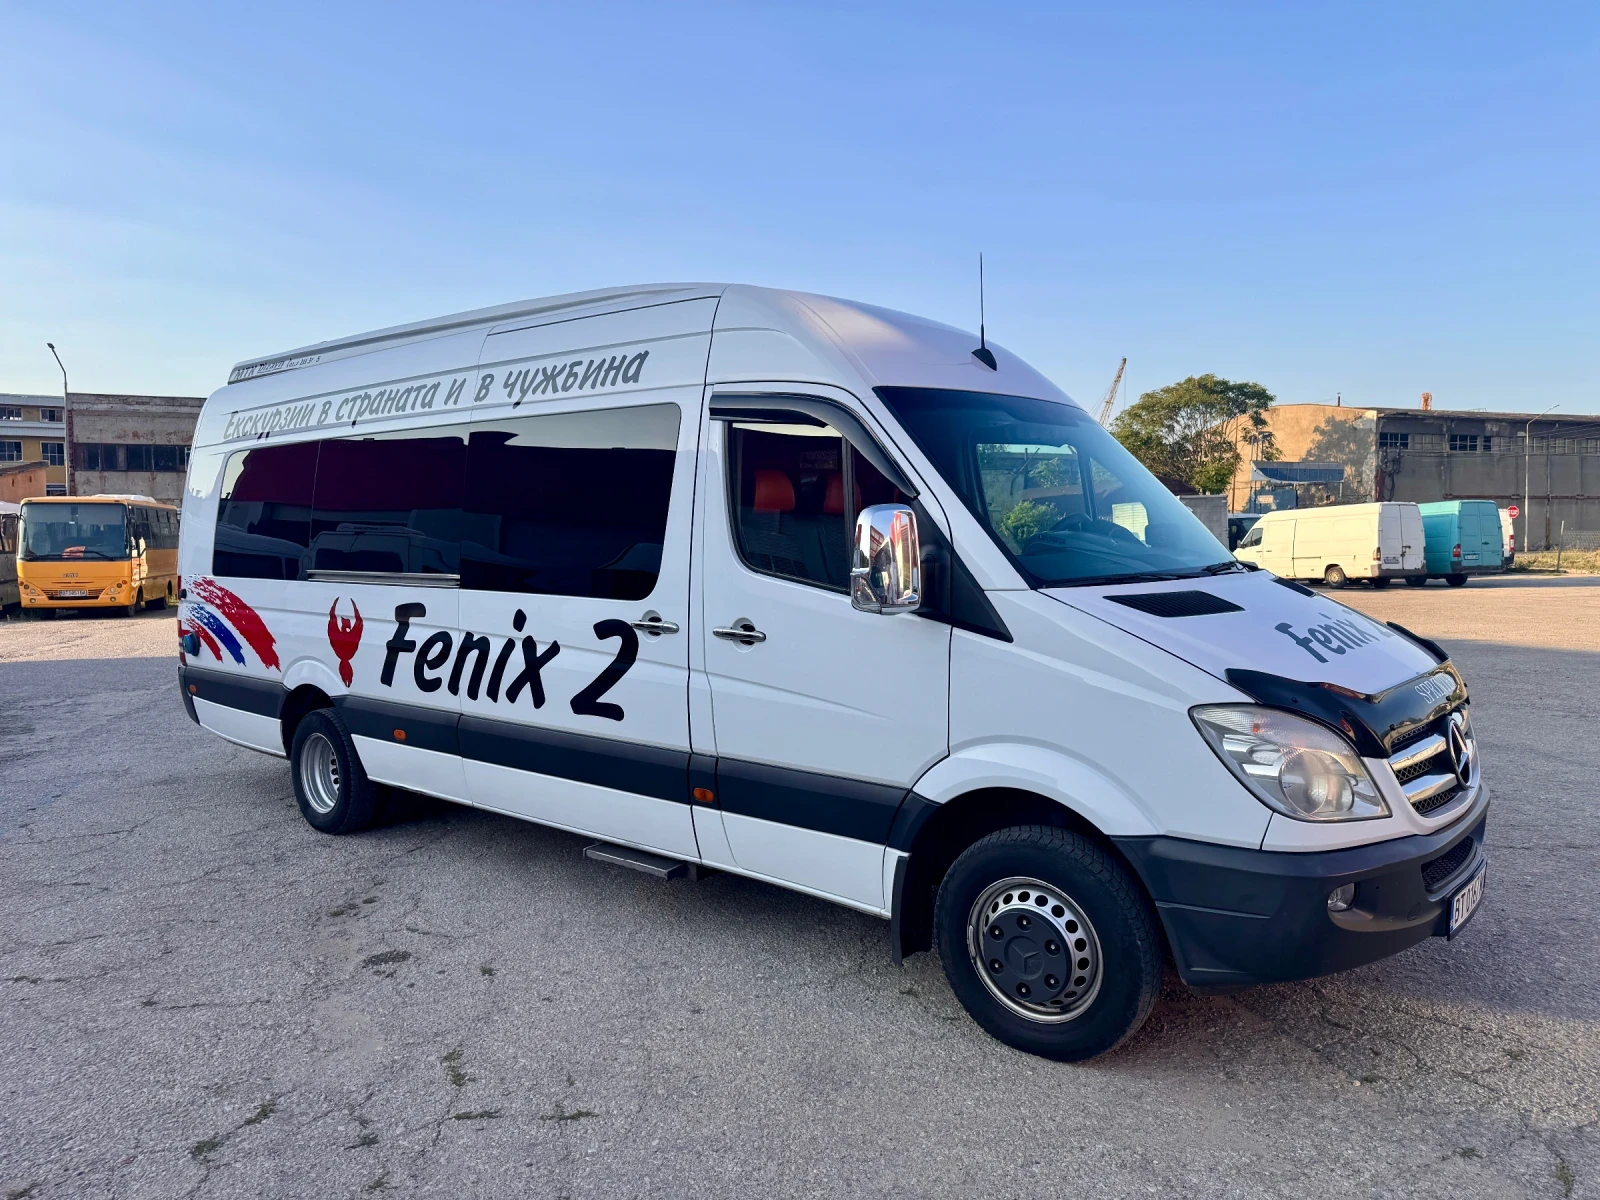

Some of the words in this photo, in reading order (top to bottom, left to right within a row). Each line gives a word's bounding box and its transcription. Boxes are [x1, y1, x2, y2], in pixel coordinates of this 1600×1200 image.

[223, 403, 316, 442] Екскурзии
[316, 400, 332, 426] в
[335, 381, 441, 429] страната
[443, 377, 467, 406] и
[474, 373, 495, 403] в
[503, 350, 649, 409] чужбина
[380, 602, 561, 709] Fenix
[570, 618, 639, 722] 2
[1274, 612, 1380, 663] Fenix
